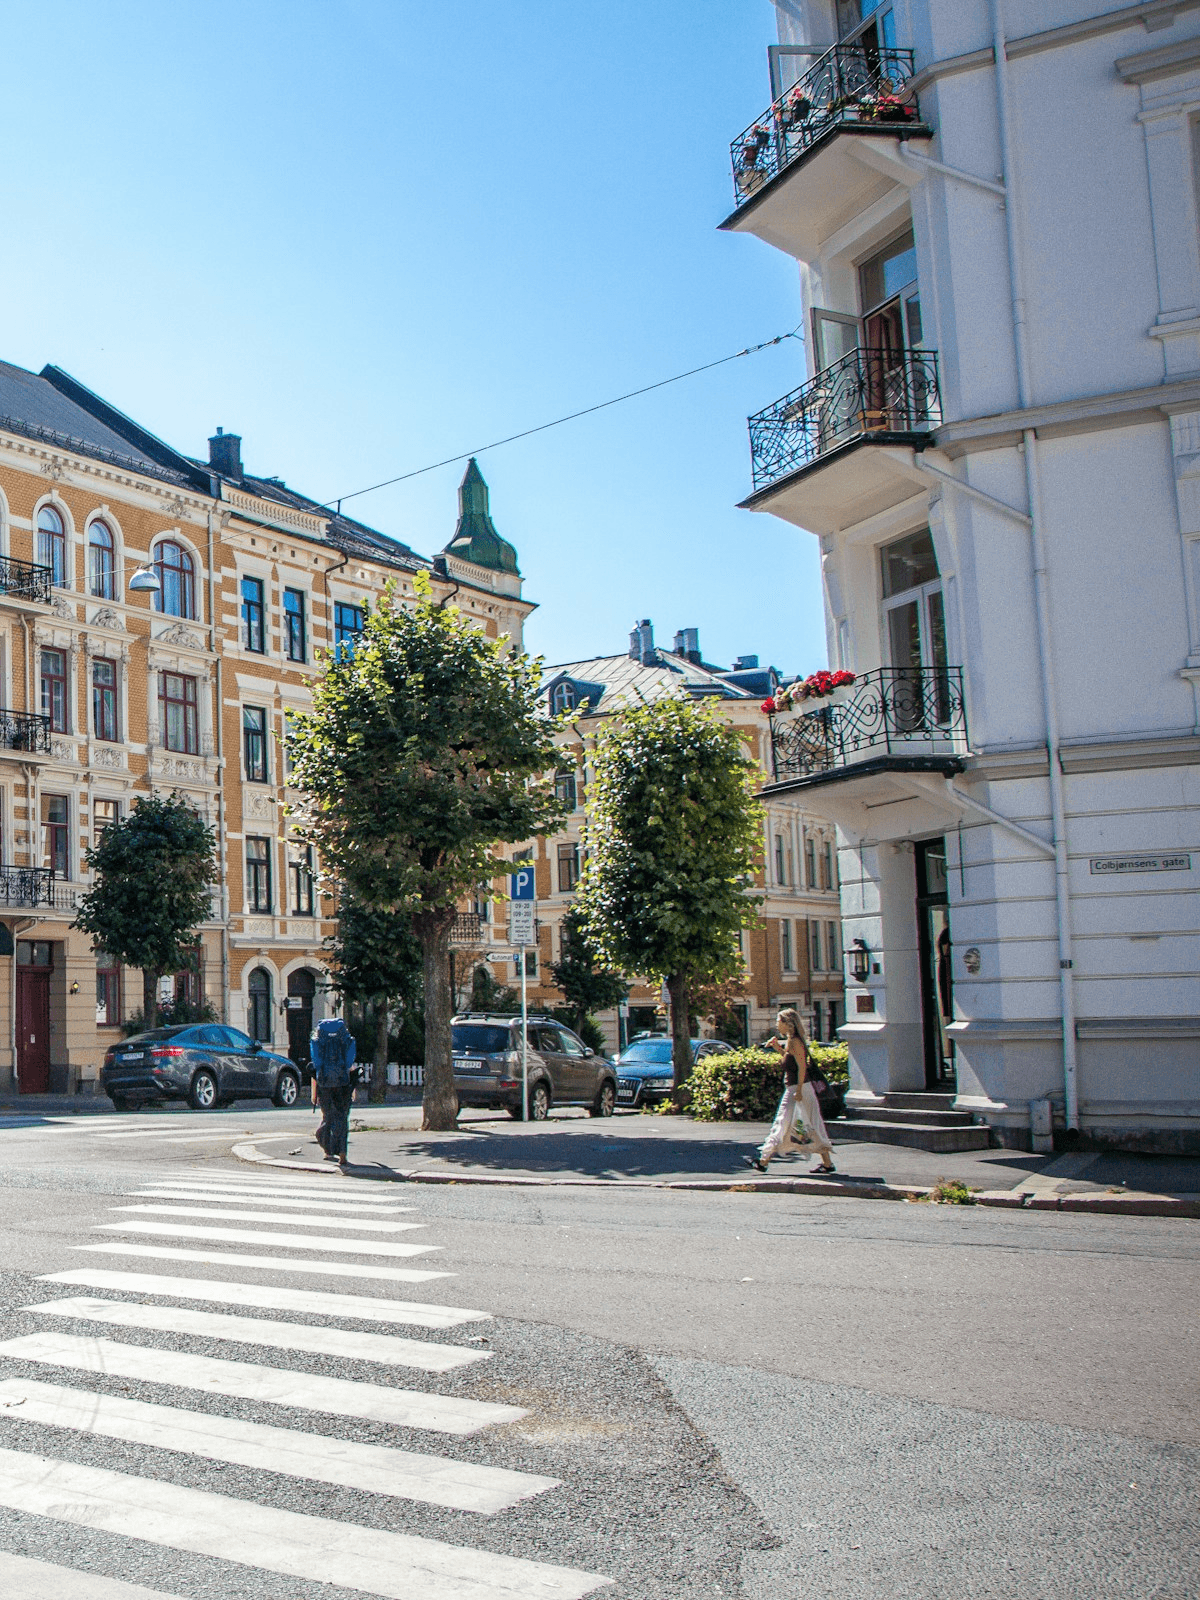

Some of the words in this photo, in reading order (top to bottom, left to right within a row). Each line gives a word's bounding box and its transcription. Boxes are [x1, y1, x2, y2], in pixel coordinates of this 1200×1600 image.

[1095, 860, 1158, 870] Colbjørnsens
[1162, 857, 1185, 868] gate
[516, 871, 529, 896] P
